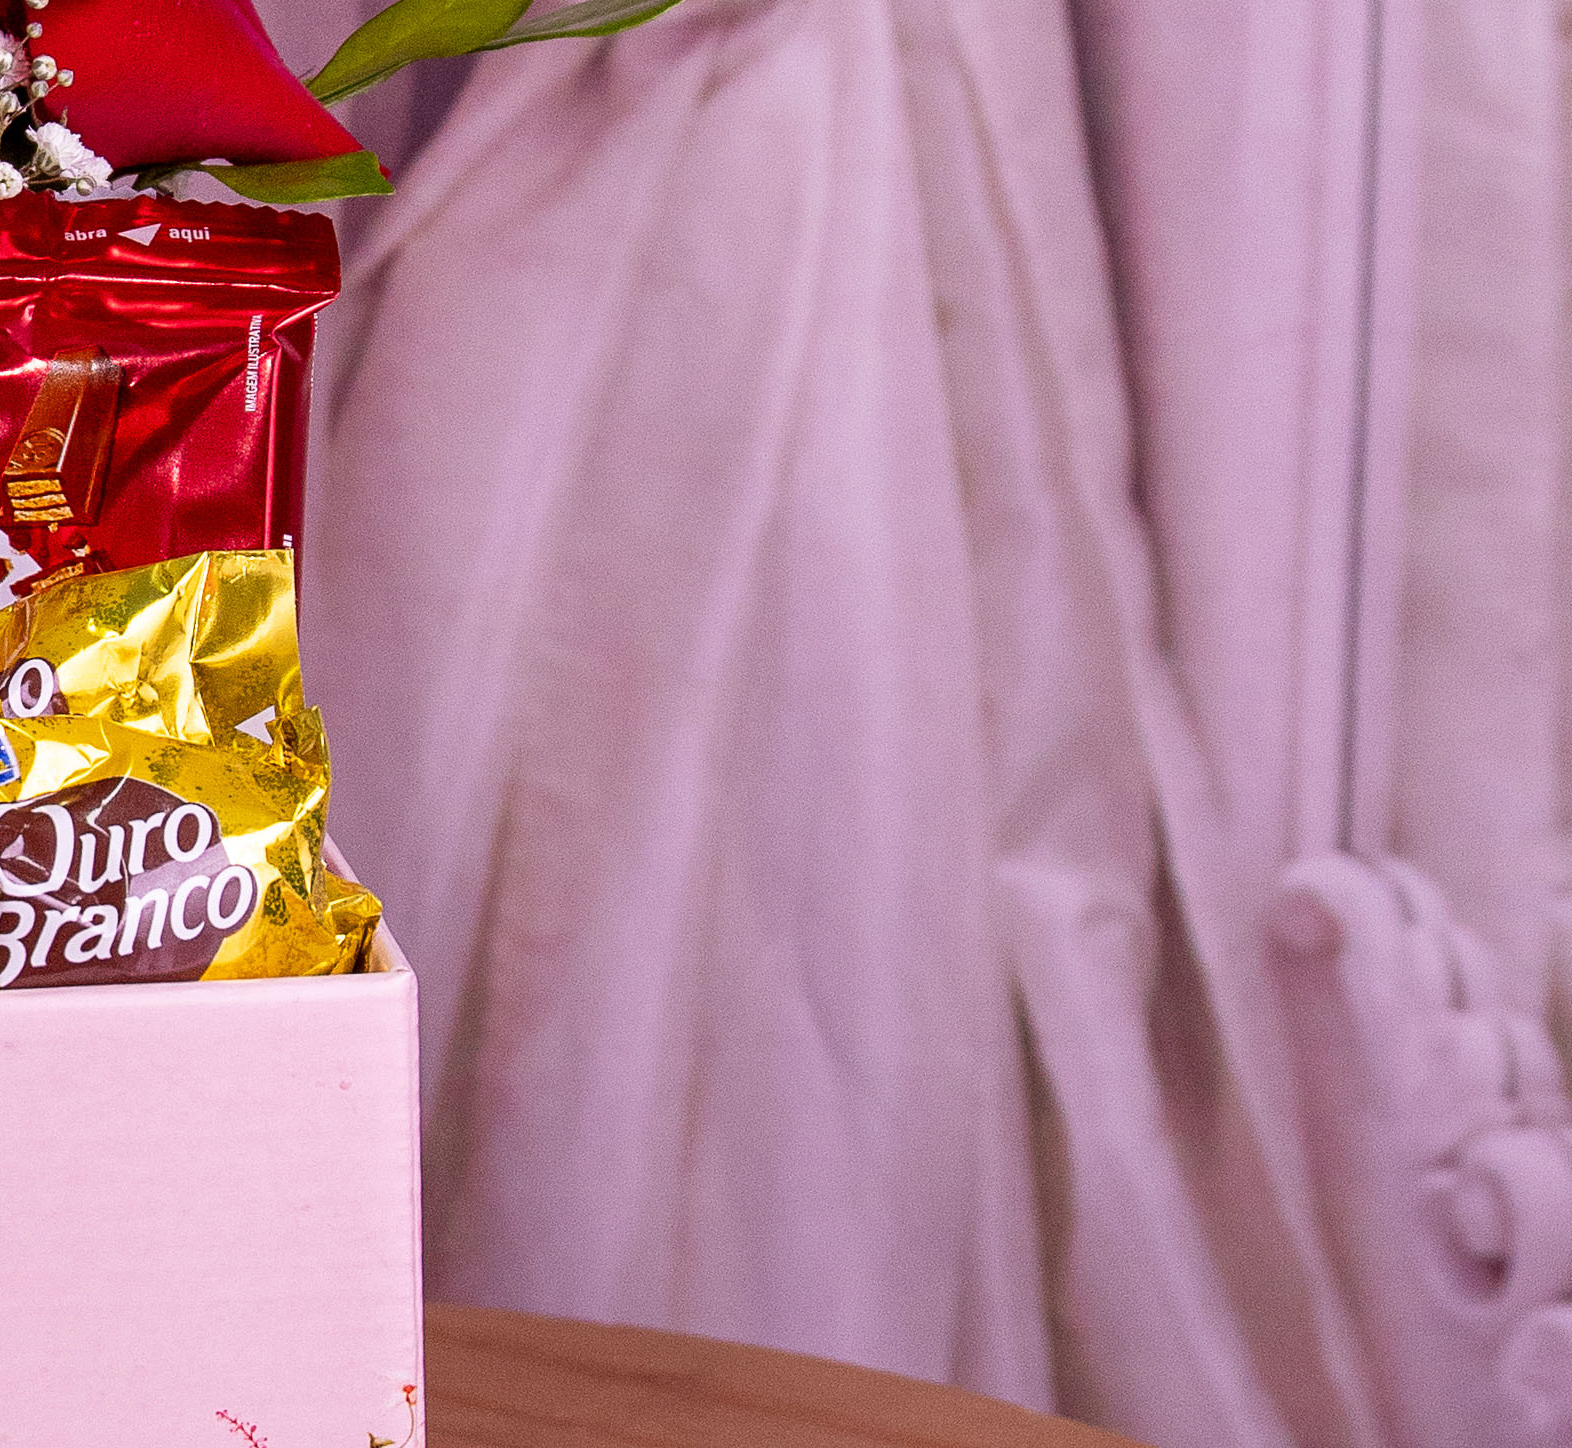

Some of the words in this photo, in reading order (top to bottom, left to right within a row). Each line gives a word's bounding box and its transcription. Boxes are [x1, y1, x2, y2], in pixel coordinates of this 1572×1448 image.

[64, 227, 107, 242] abra
[169, 226, 211, 243] aqui
[245, 371, 259, 412] IMAGEM
